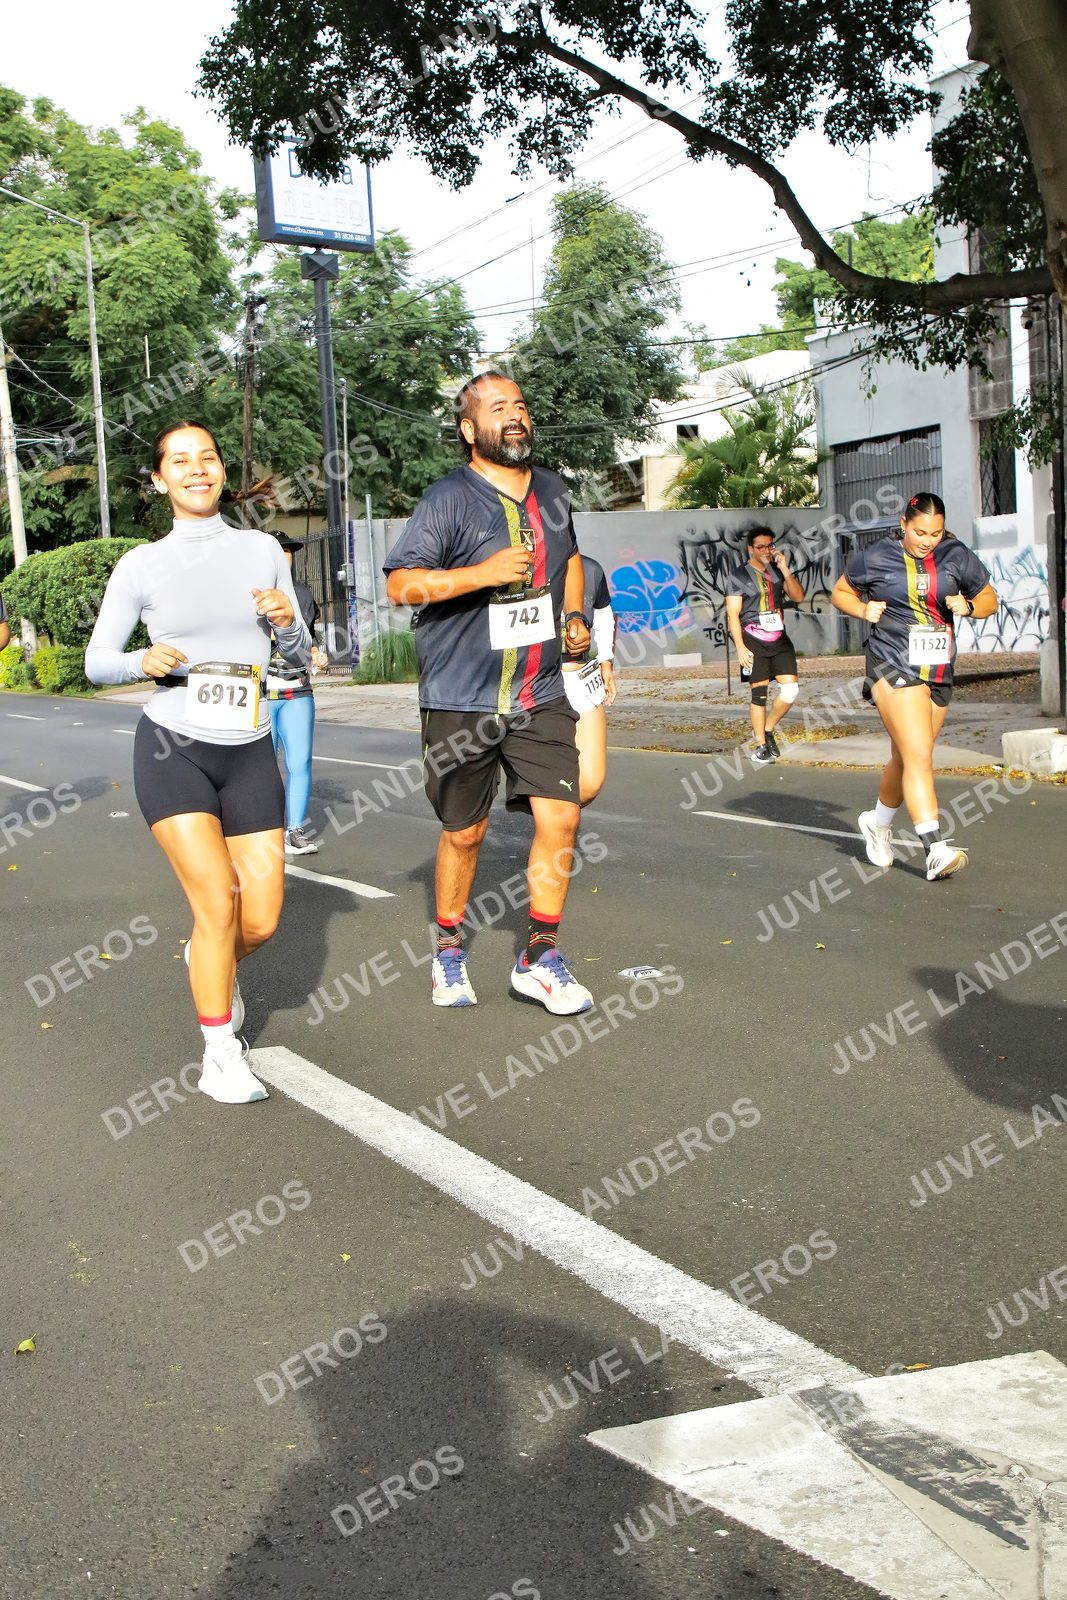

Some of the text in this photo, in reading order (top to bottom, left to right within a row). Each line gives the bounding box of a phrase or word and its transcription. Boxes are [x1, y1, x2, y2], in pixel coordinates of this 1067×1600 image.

[508, 606, 540, 628] 742
[912, 637, 947, 650] 11522
[197, 682, 248, 707] 6912
